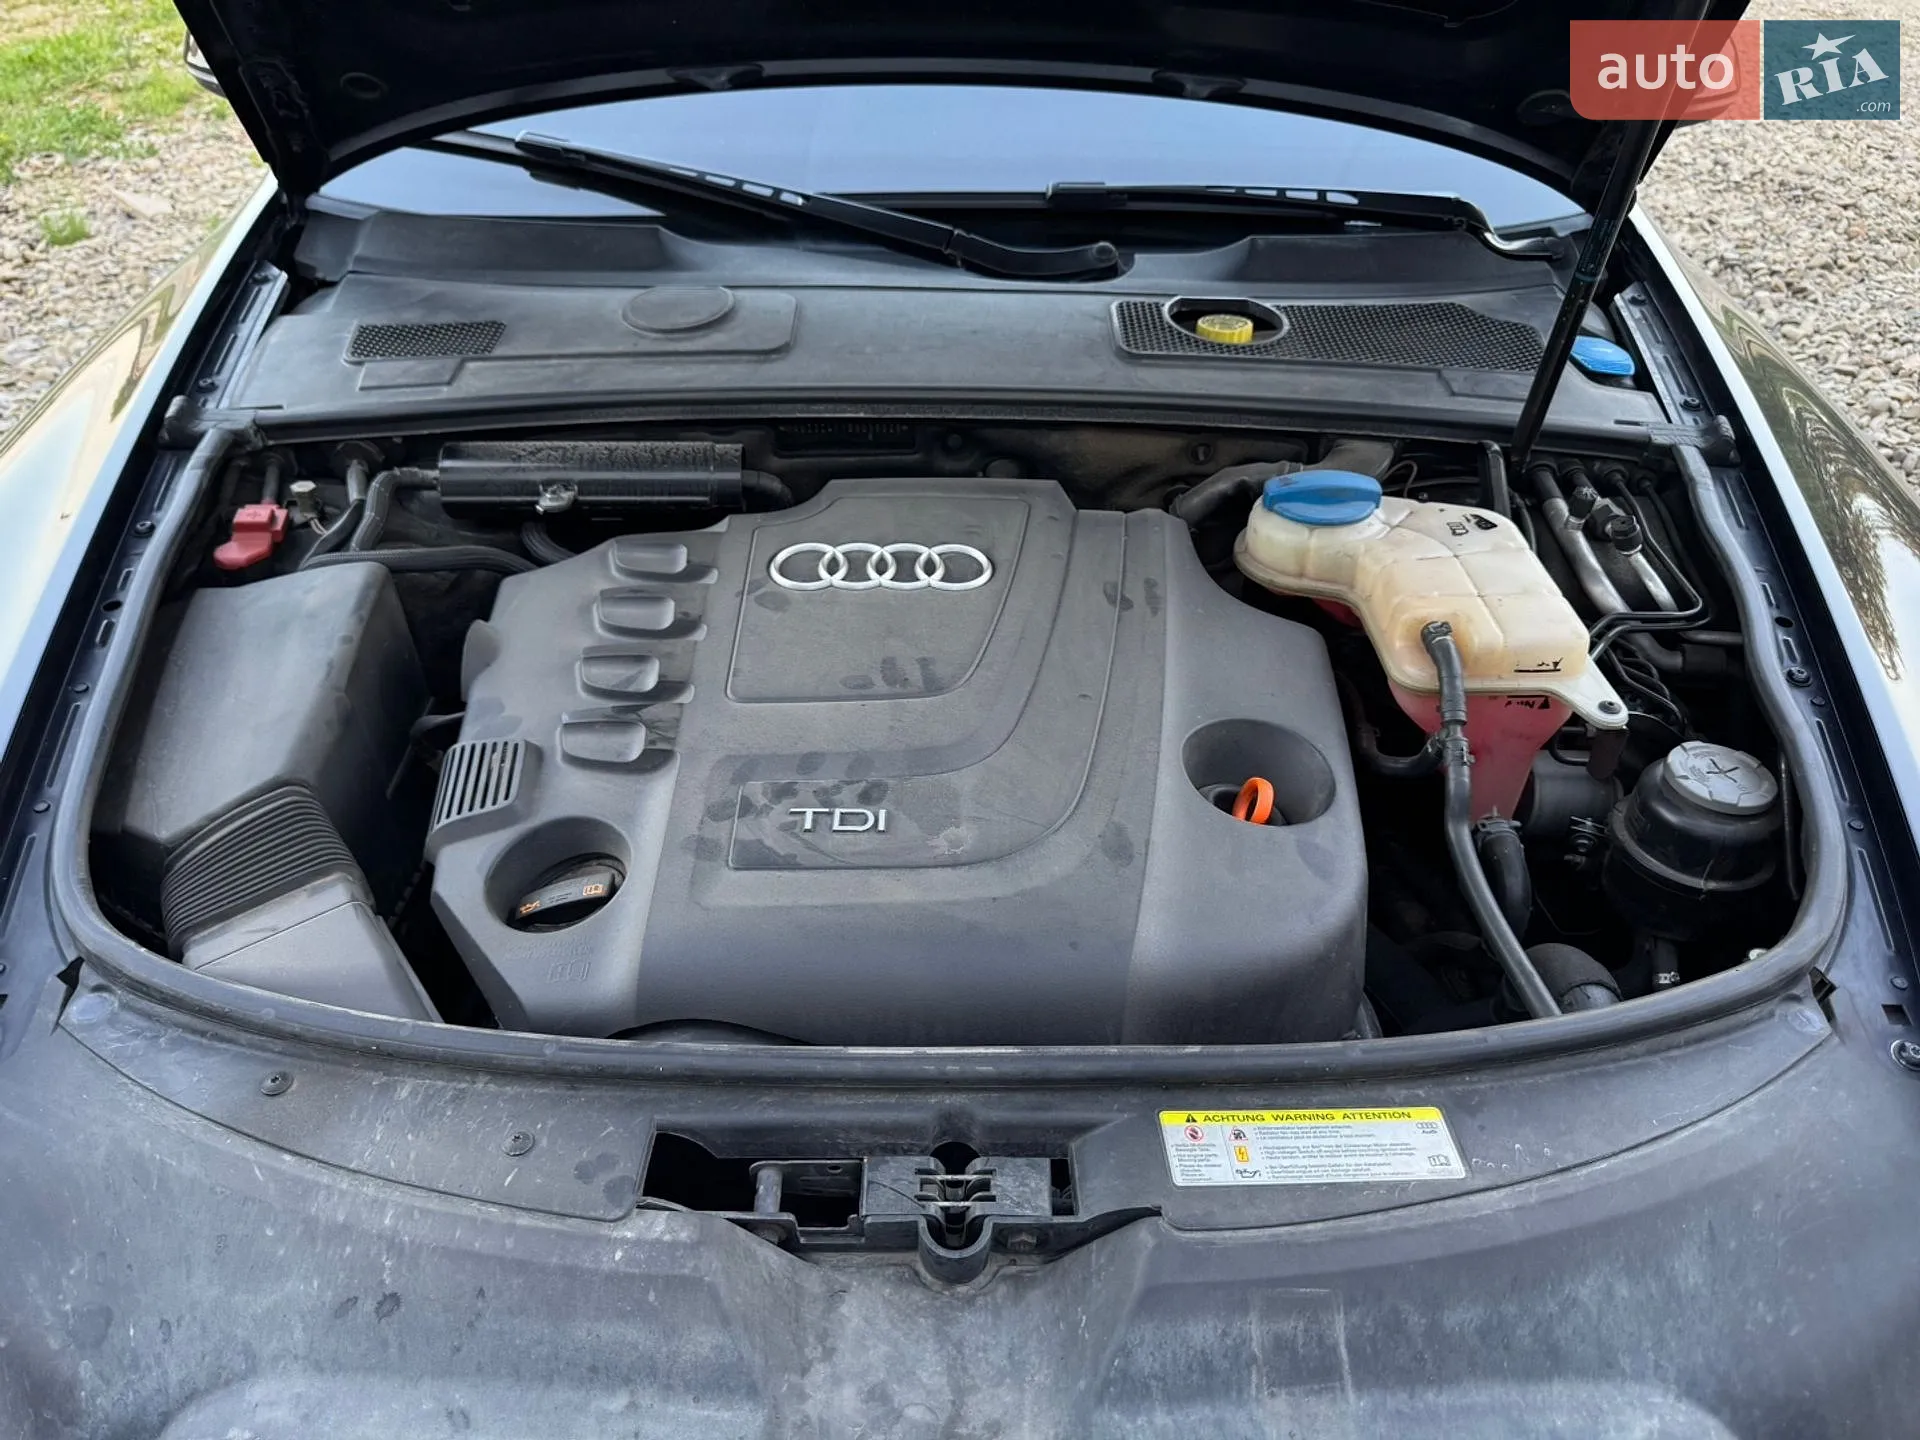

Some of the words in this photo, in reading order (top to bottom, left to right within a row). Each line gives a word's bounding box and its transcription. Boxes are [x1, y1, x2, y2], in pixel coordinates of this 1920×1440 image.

[789, 807, 888, 832] TDI
[1203, 1113, 1265, 1122] ACHTUNG
[1270, 1112, 1335, 1121] WARNING
[1342, 1111, 1412, 1120] ATTENTION
